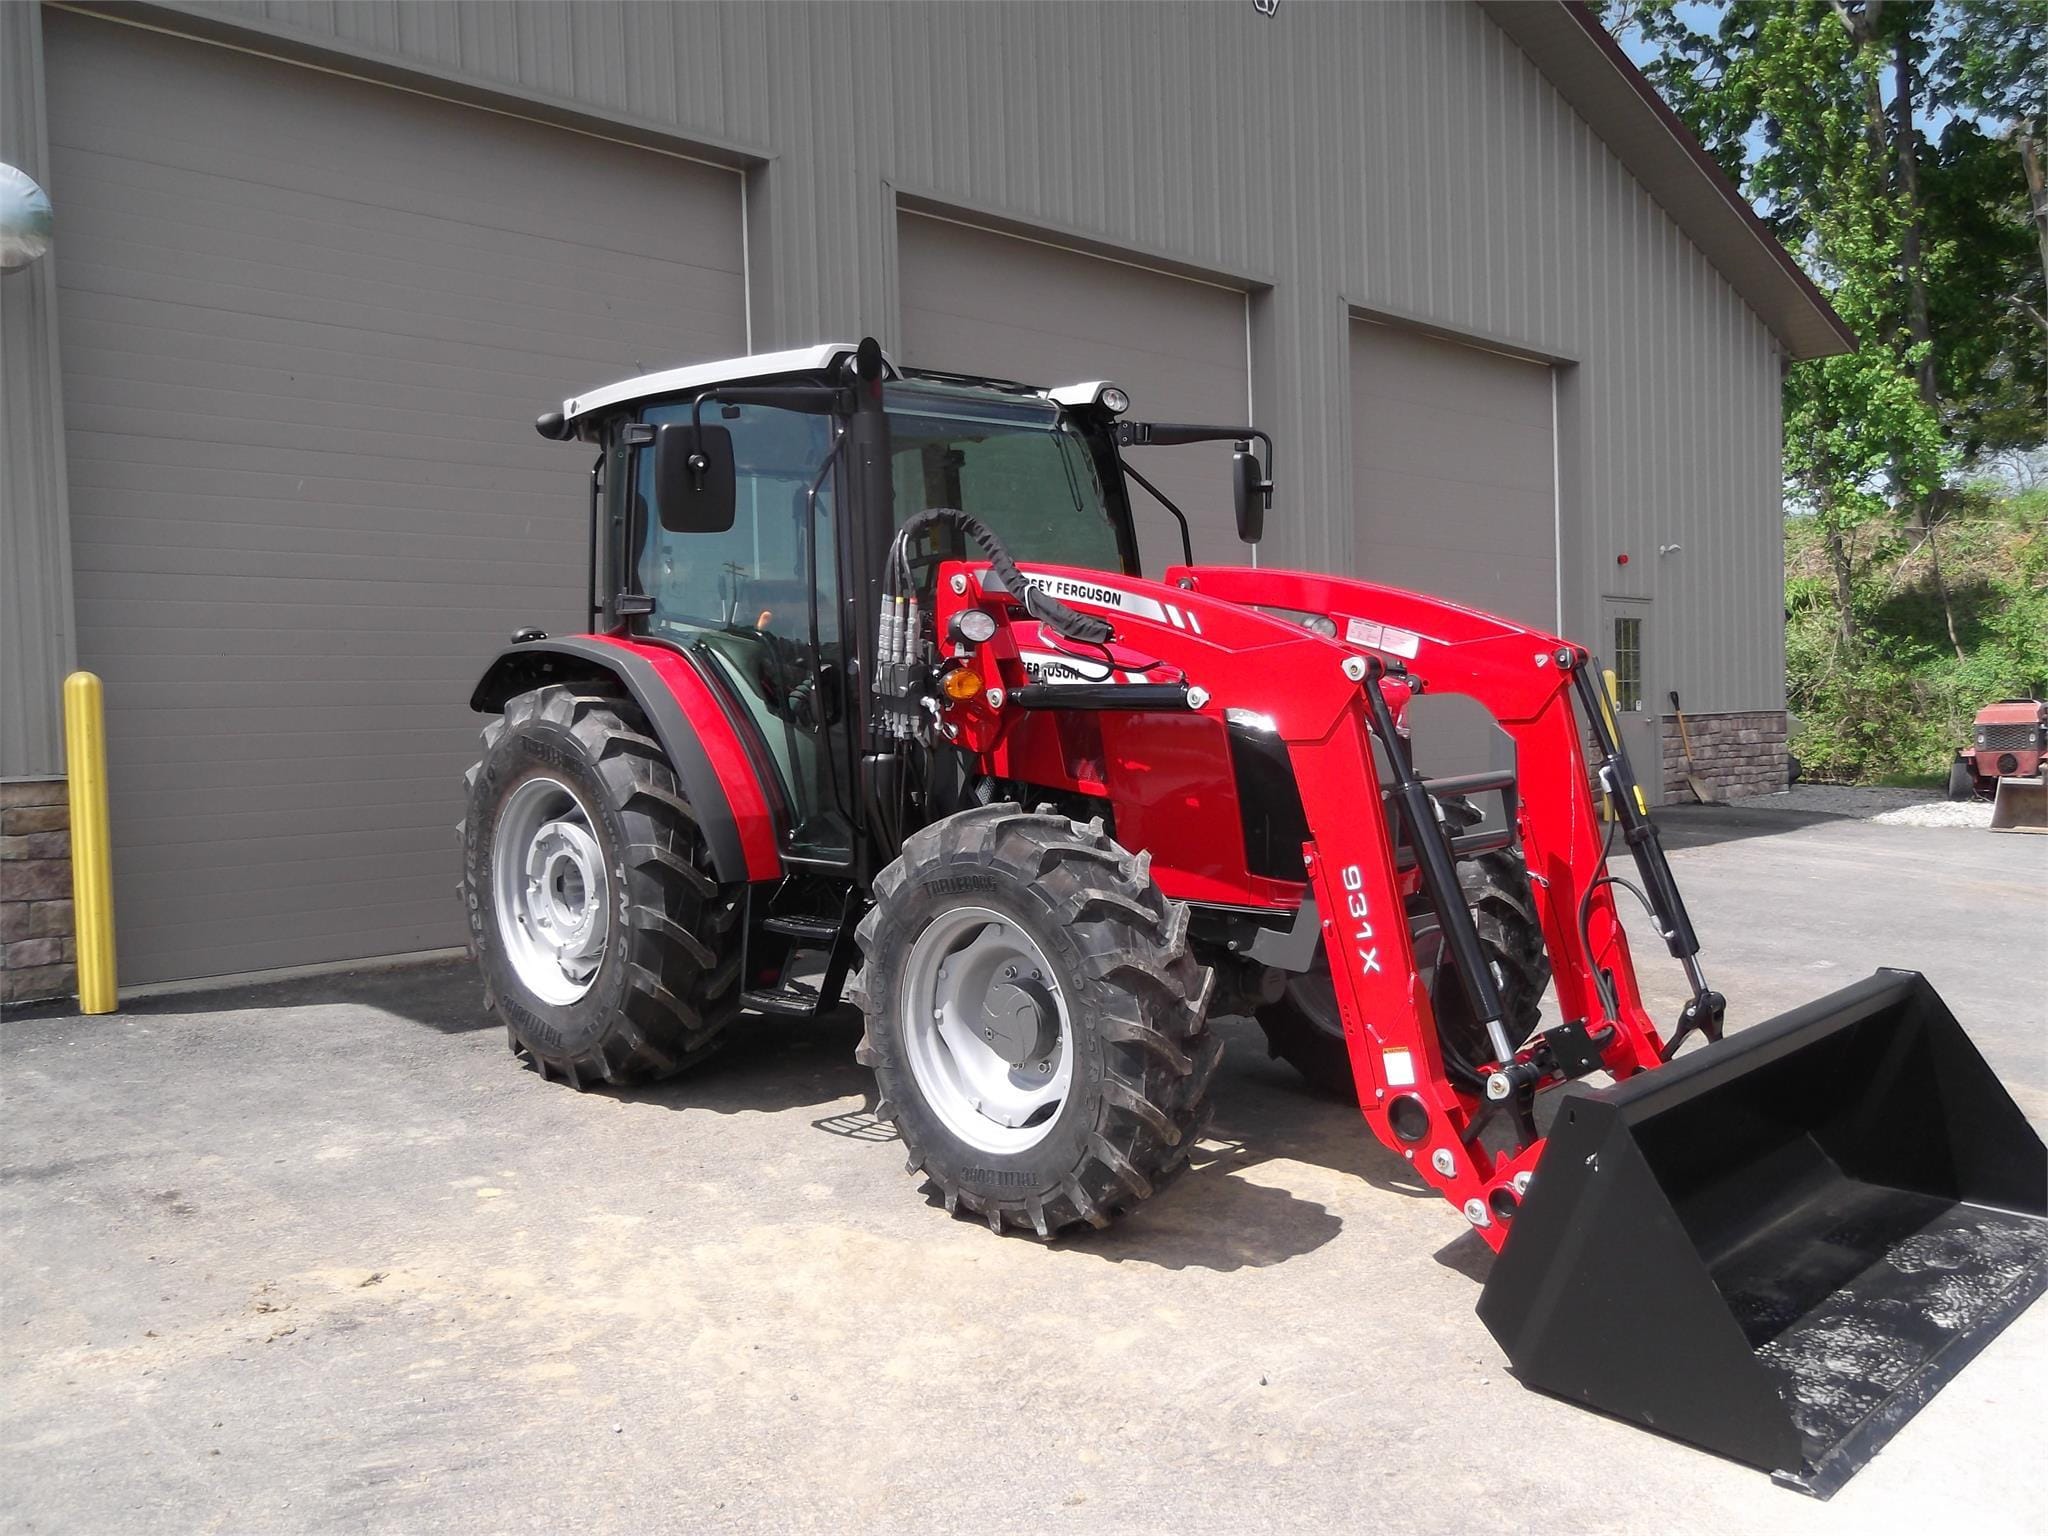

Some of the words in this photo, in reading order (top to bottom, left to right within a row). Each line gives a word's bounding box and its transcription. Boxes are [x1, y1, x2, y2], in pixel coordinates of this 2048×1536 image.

[1057, 581, 1122, 607] FERGUSON
[1022, 661, 1080, 680] ERUSON
[1342, 865, 1381, 975] 931X
